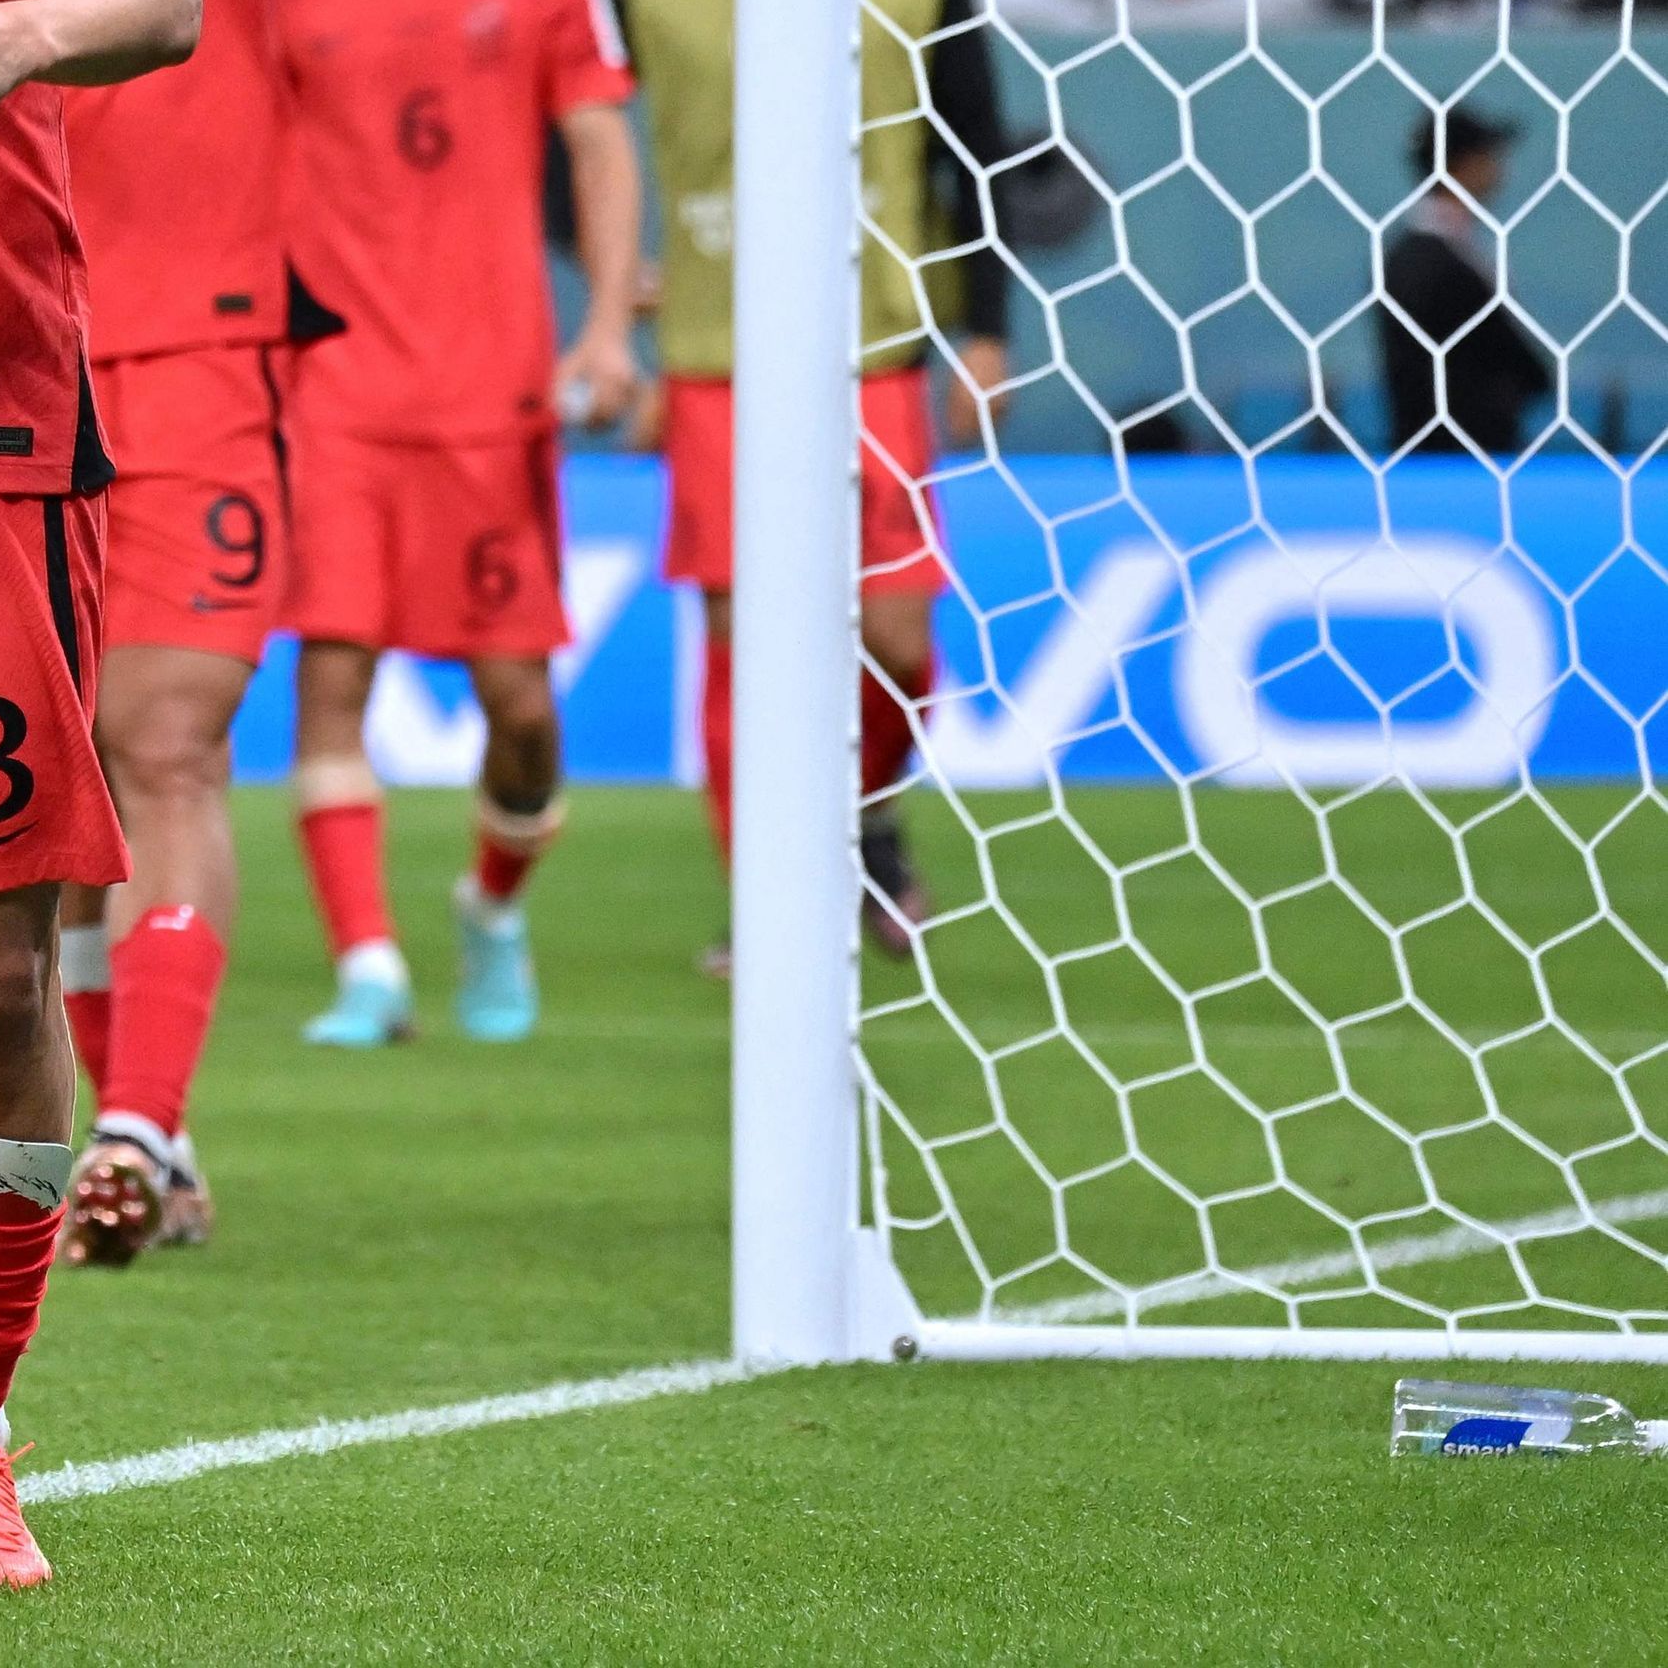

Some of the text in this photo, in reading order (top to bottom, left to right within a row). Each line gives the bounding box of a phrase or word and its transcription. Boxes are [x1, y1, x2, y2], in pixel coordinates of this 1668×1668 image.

[396, 86, 454, 172] 6
[207, 495, 264, 587] 9
[466, 529, 518, 609] 6
